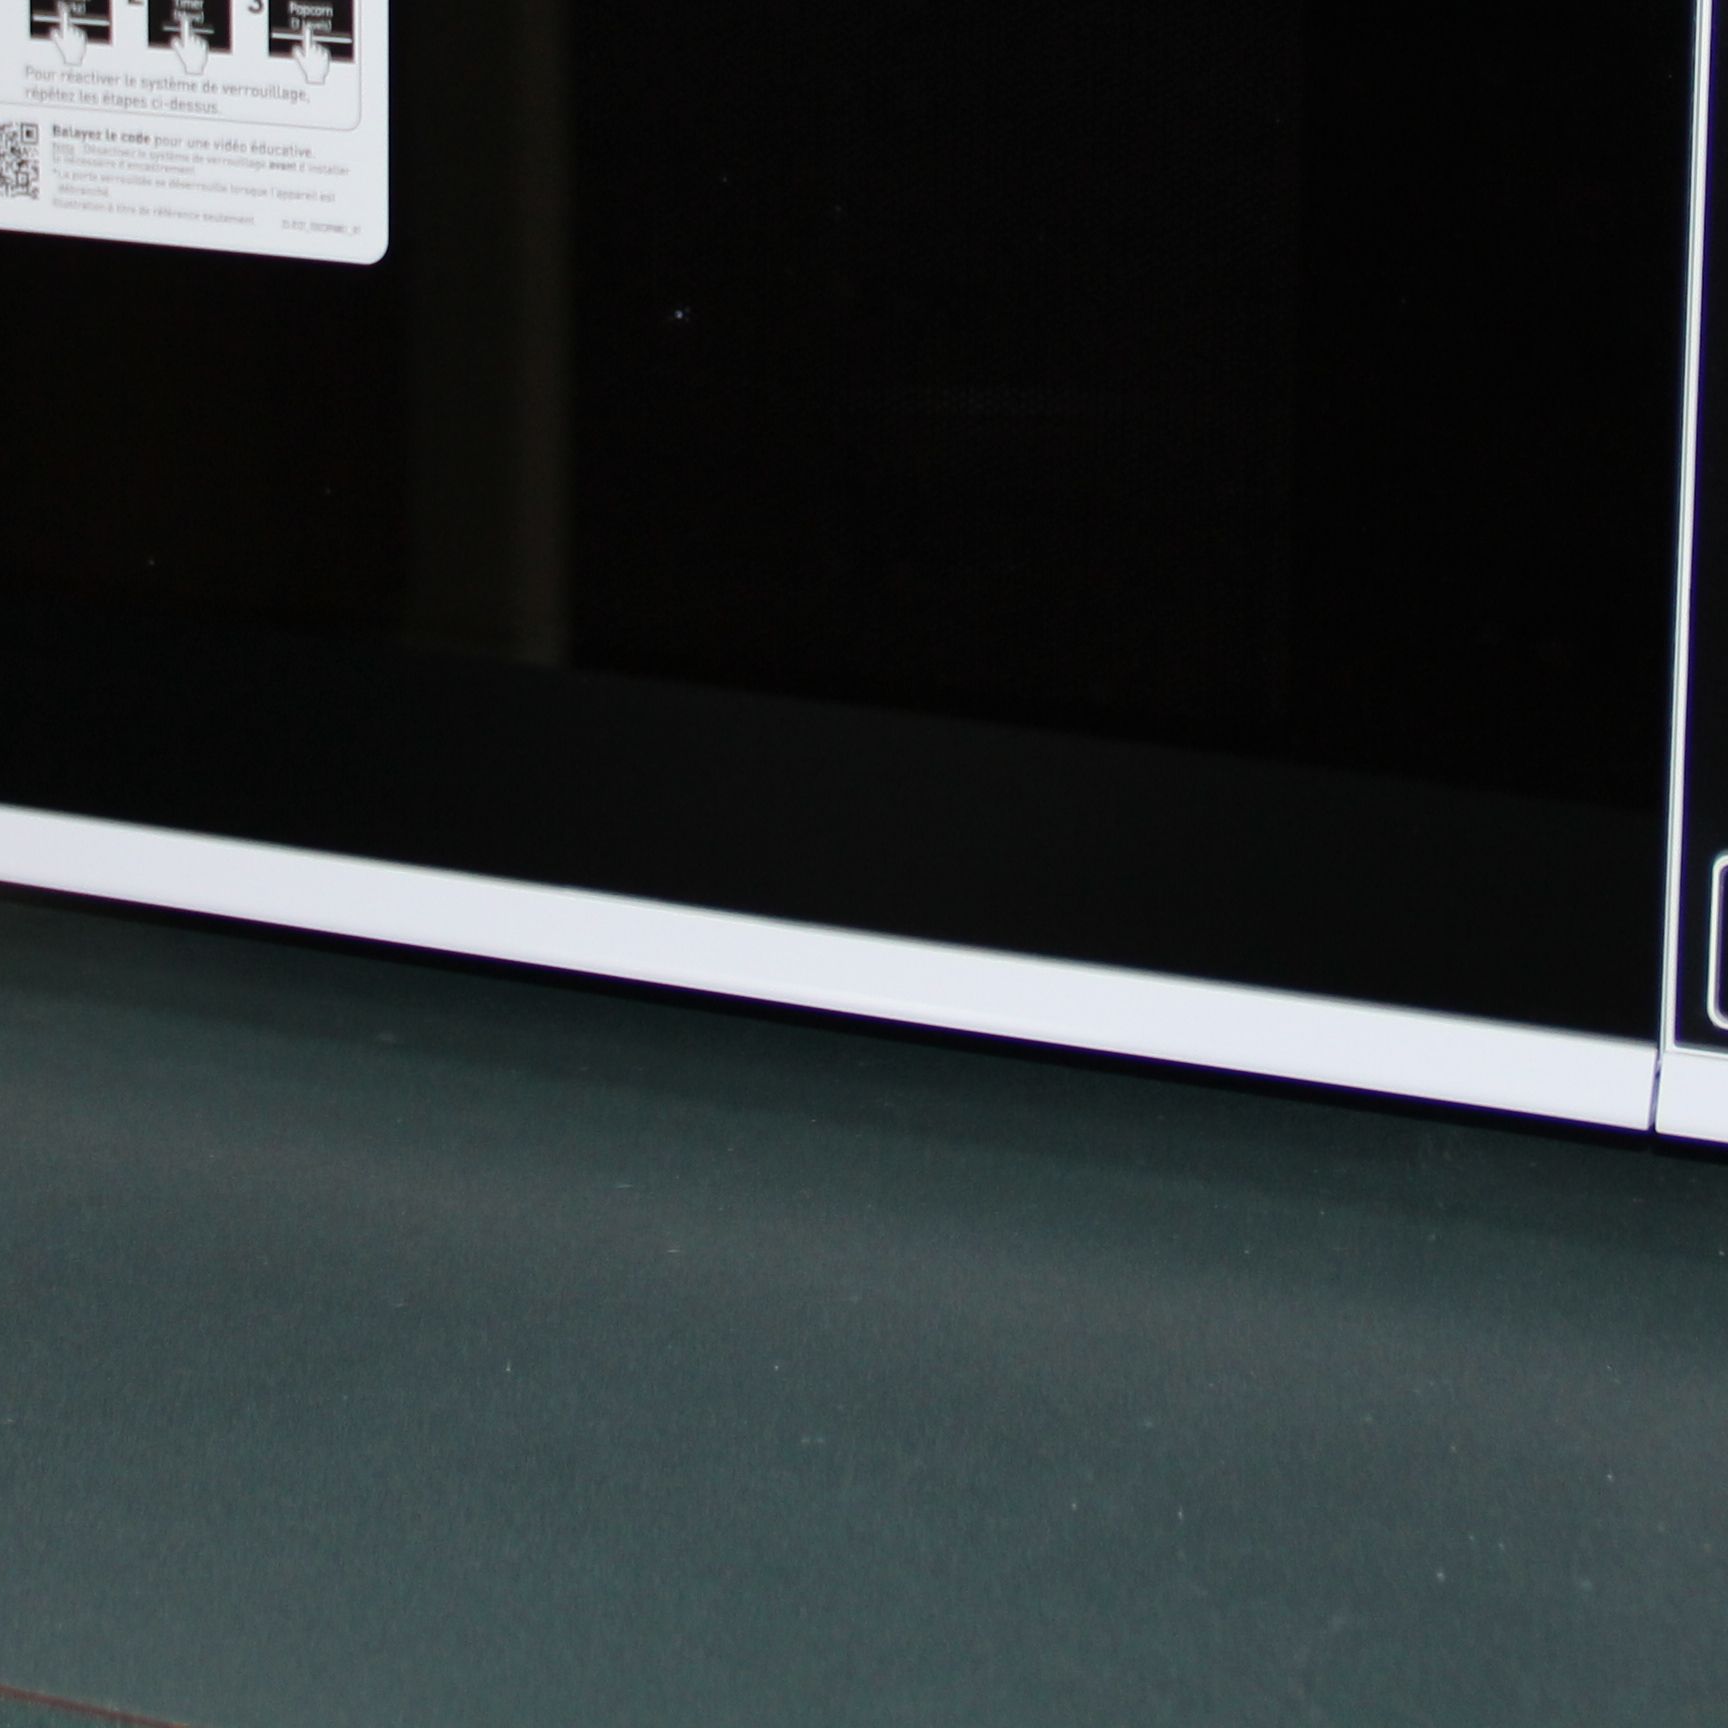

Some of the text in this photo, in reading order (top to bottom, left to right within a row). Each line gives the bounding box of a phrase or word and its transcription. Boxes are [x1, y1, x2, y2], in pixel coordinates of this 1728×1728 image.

[25, 67, 56, 82] Pour
[60, 70, 120, 87] réactiver
[126, 74, 137, 88] le
[141, 77, 196, 94] système
[202, 80, 219, 94] de
[26, 86, 147, 111] répétez les étapes
[53, 125, 247, 152] Balayez le code pour une vidéo
